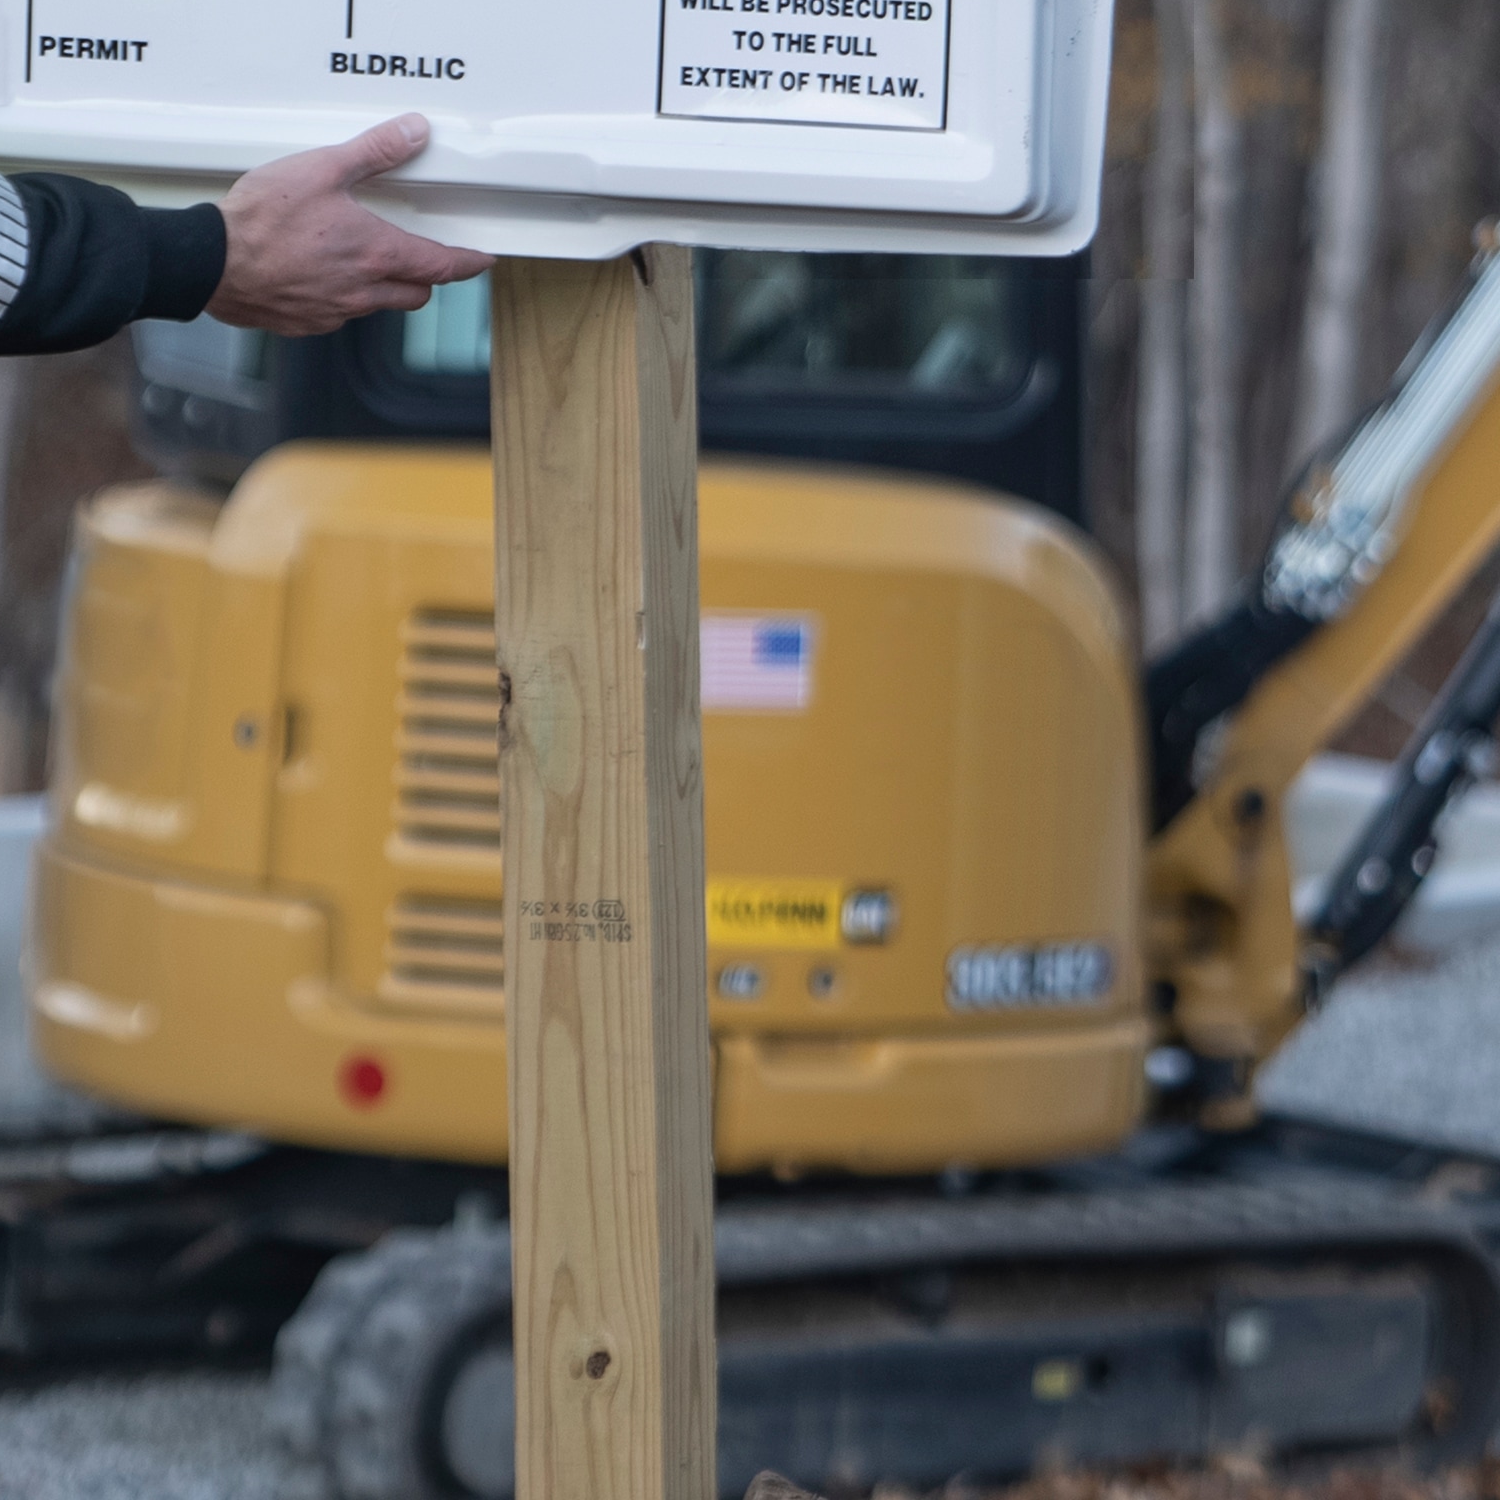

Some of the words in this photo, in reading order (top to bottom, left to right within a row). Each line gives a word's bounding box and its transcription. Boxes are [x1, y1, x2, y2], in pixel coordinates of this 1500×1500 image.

[39, 35, 149, 62] PERMIT
[732, 30, 765, 52] TO
[771, 32, 817, 54] THE
[823, 35, 878, 57] FULL
[330, 52, 466, 80] BLDR.LIC
[680, 66, 773, 90] EXTENT
[780, 70, 811, 92] OF
[817, 73, 862, 95] THE
[868, 75, 925, 98] LAW.
